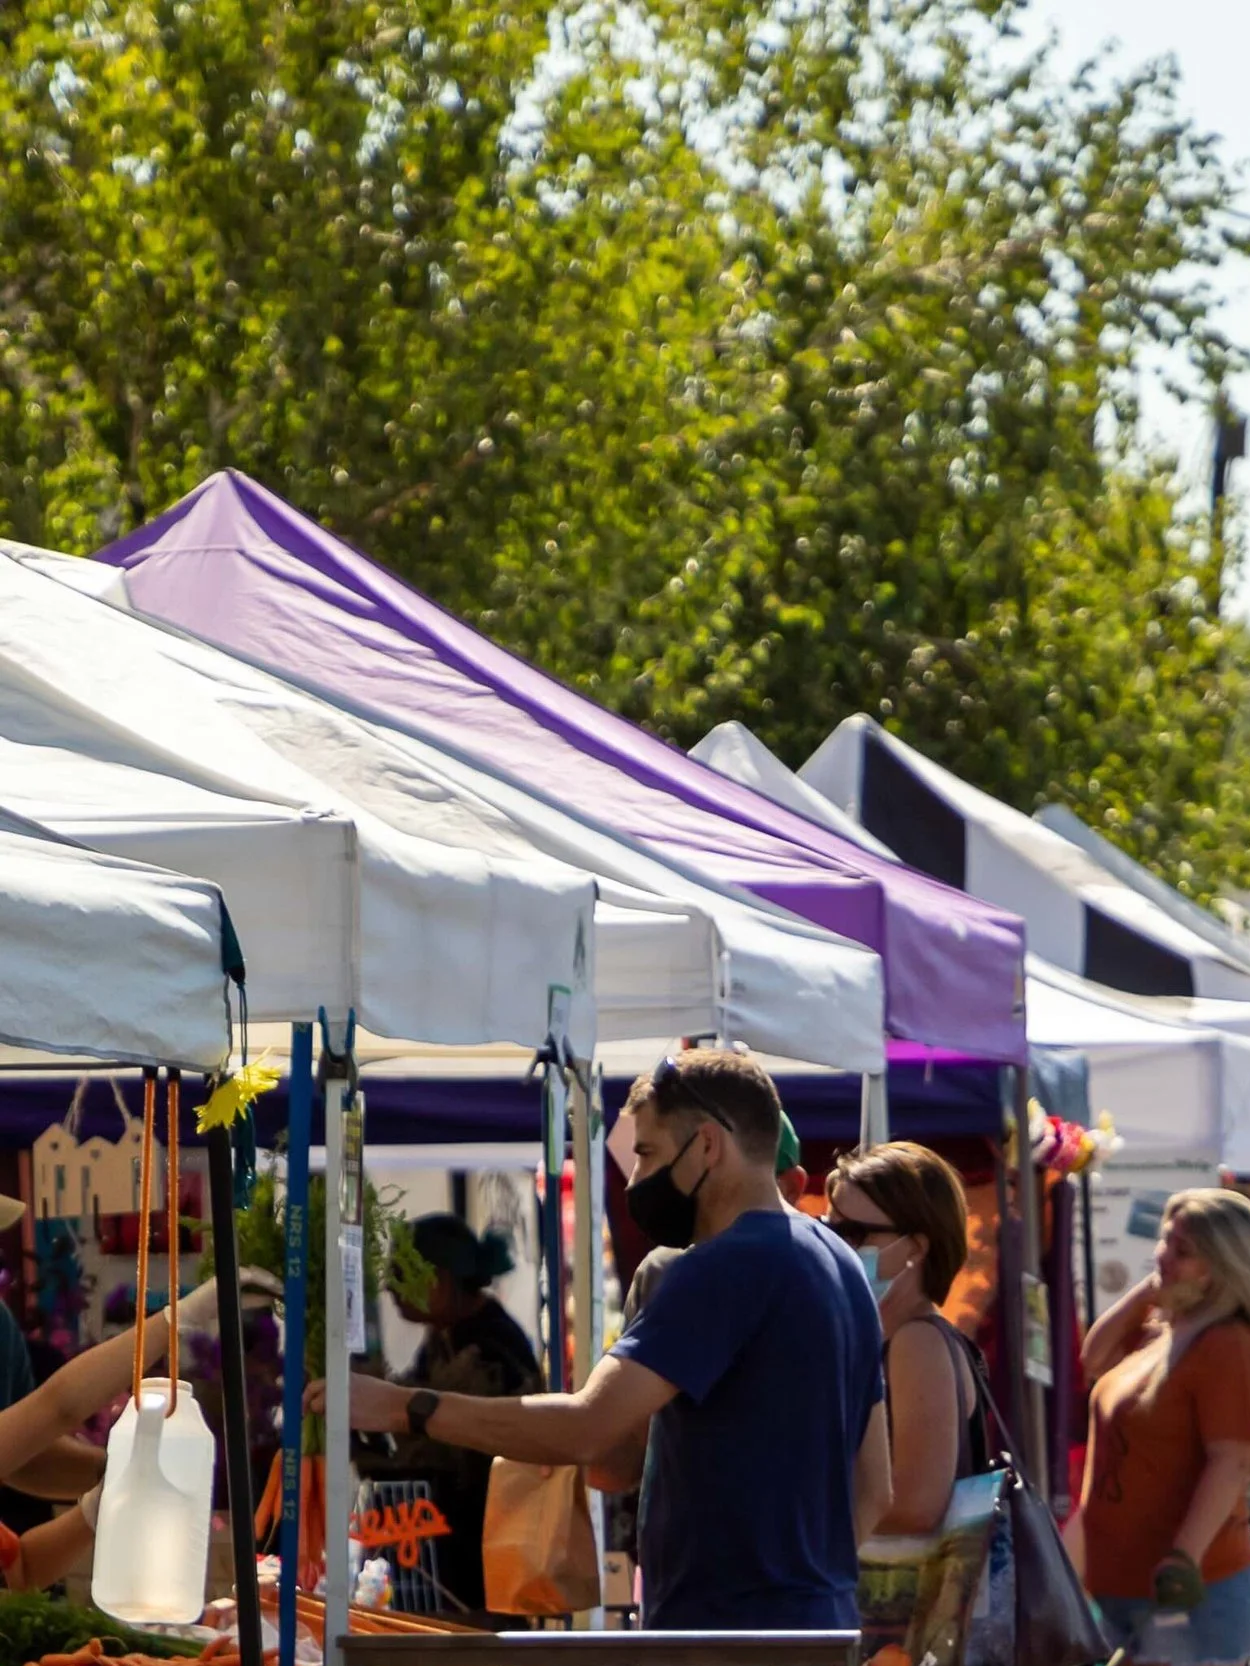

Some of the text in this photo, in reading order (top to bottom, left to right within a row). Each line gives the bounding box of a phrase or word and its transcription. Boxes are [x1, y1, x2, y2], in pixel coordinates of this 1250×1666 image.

[287, 1203, 304, 1279] NRS 12
[282, 1447, 298, 1522] NRS 12
